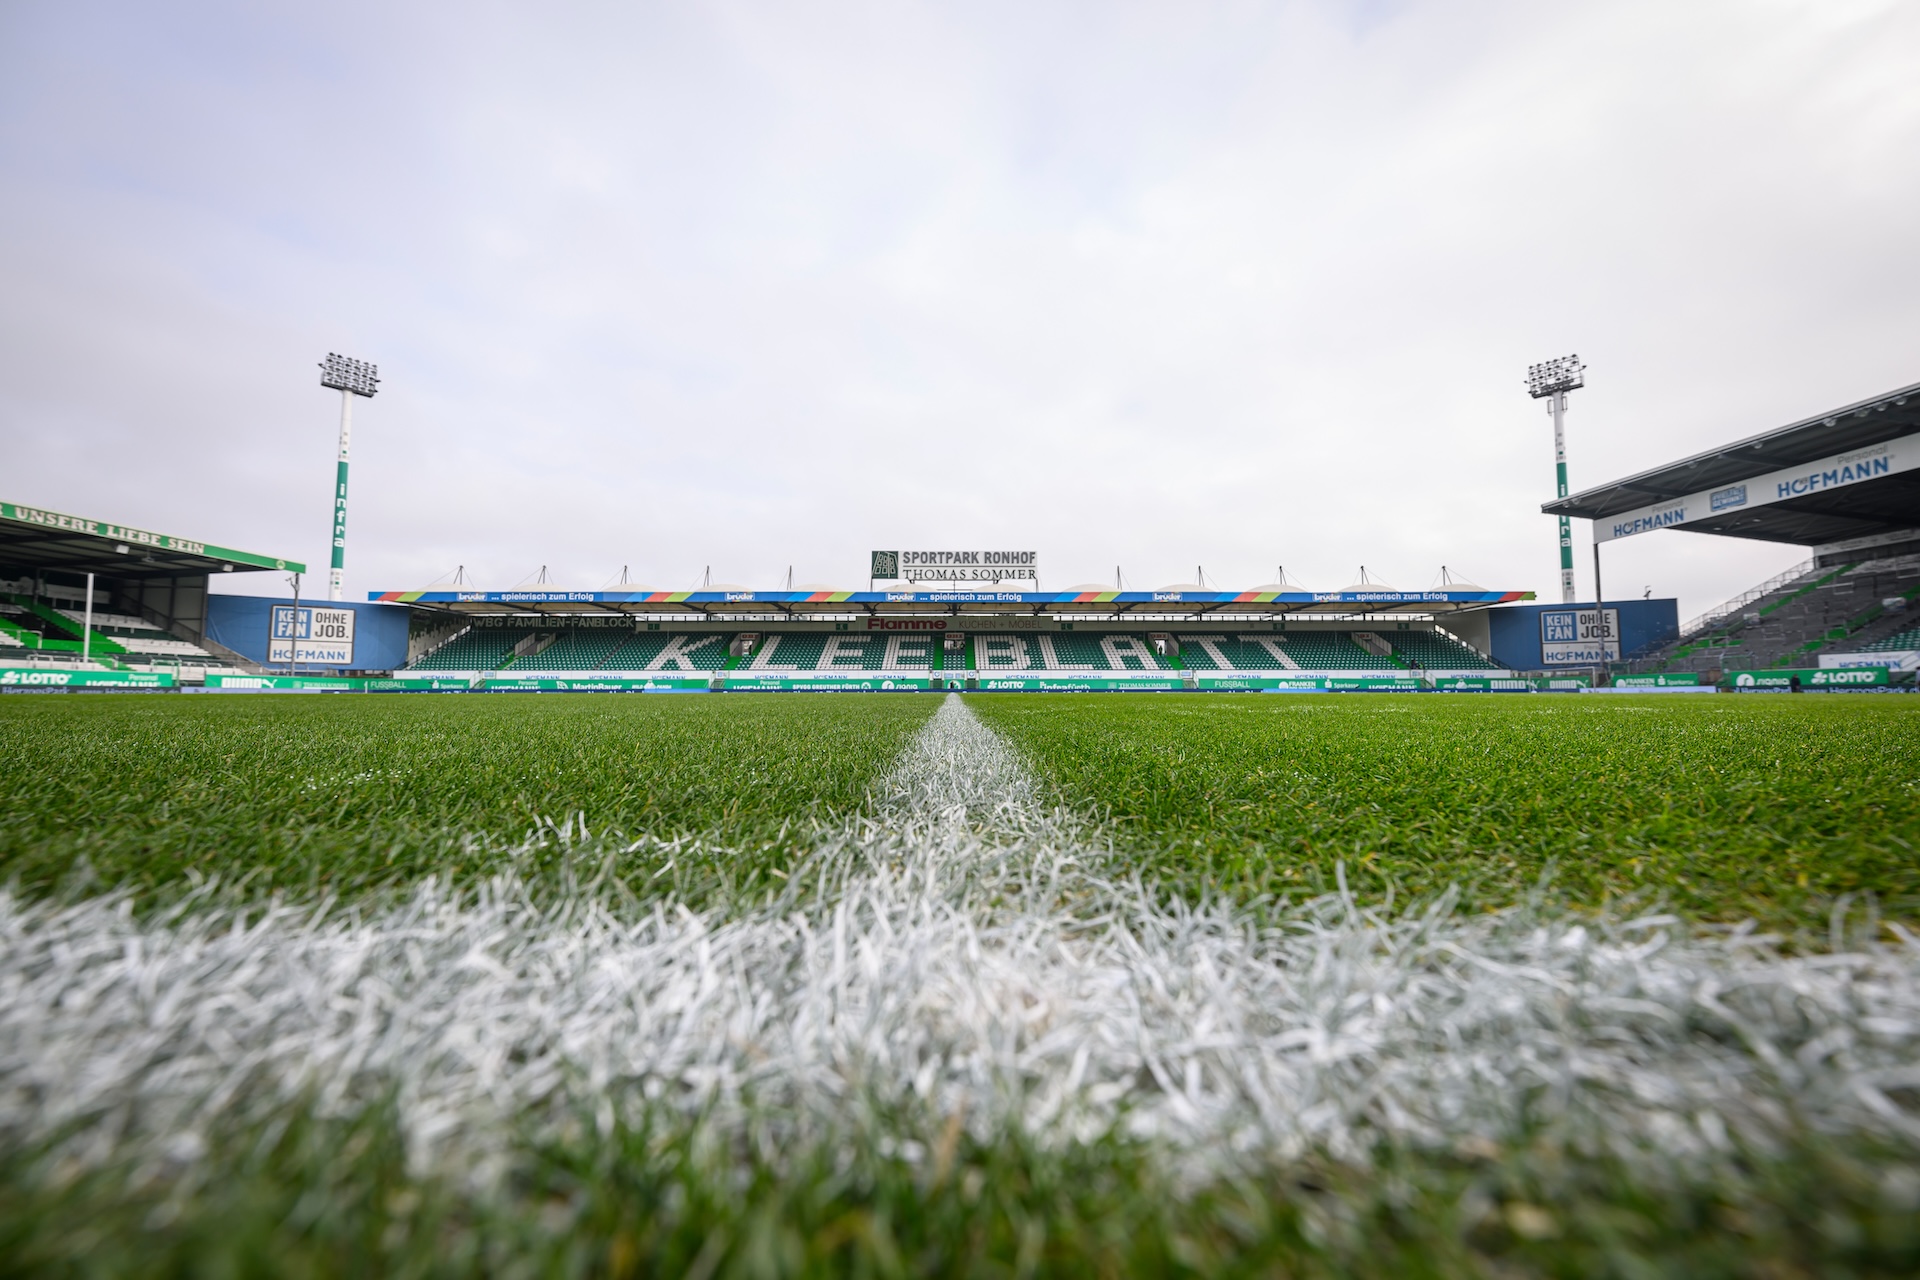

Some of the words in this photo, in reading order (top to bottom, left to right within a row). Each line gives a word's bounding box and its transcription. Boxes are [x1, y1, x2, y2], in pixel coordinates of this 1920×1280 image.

[1837, 444, 1888, 465] Personal
[1777, 456, 1889, 498] HOFMANN
[1652, 500, 1684, 513] Personal
[334, 484, 346, 548] infra
[1560, 484, 1572, 547] ira
[1613, 508, 1685, 538] HOFMANN
[14, 506, 99, 534] UNSERE
[106, 524, 162, 546] LIEBE
[168, 538, 205, 554] SEIN
[902, 552, 980, 564] SPORTPARK
[984, 552, 1036, 564] RONHOF
[902, 569, 966, 580] THOMAS
[972, 569, 1036, 580] SOMMER
[501, 592, 547, 602] spielerisch
[568, 592, 594, 602] Erfolg
[726, 592, 754, 600] bruder
[930, 593, 975, 602] spielerisch
[996, 593, 1022, 602] Erfolg
[1154, 592, 1182, 600] bruder
[1356, 593, 1402, 602] spielerisch
[1422, 593, 1448, 602] Erfolg
[278, 610, 308, 623] KEN
[315, 612, 348, 624] OHNE
[1546, 614, 1572, 626] KEIN
[1580, 613, 1611, 625] OHE
[472, 618, 504, 628] WBG
[507, 618, 634, 628] FAMILIEN-FANBLOCK
[867, 618, 947, 630] Flamme
[277, 622, 306, 637] FAN
[314, 624, 349, 638] JOB.
[1547, 626, 1573, 640] FAN
[1580, 625, 1615, 639] JOB.
[273, 650, 346, 660] HOFMANN
[21, 672, 70, 685] LOTTO
[1828, 672, 1875, 682] LOTTO
[998, 681, 1023, 689] LOTTO
